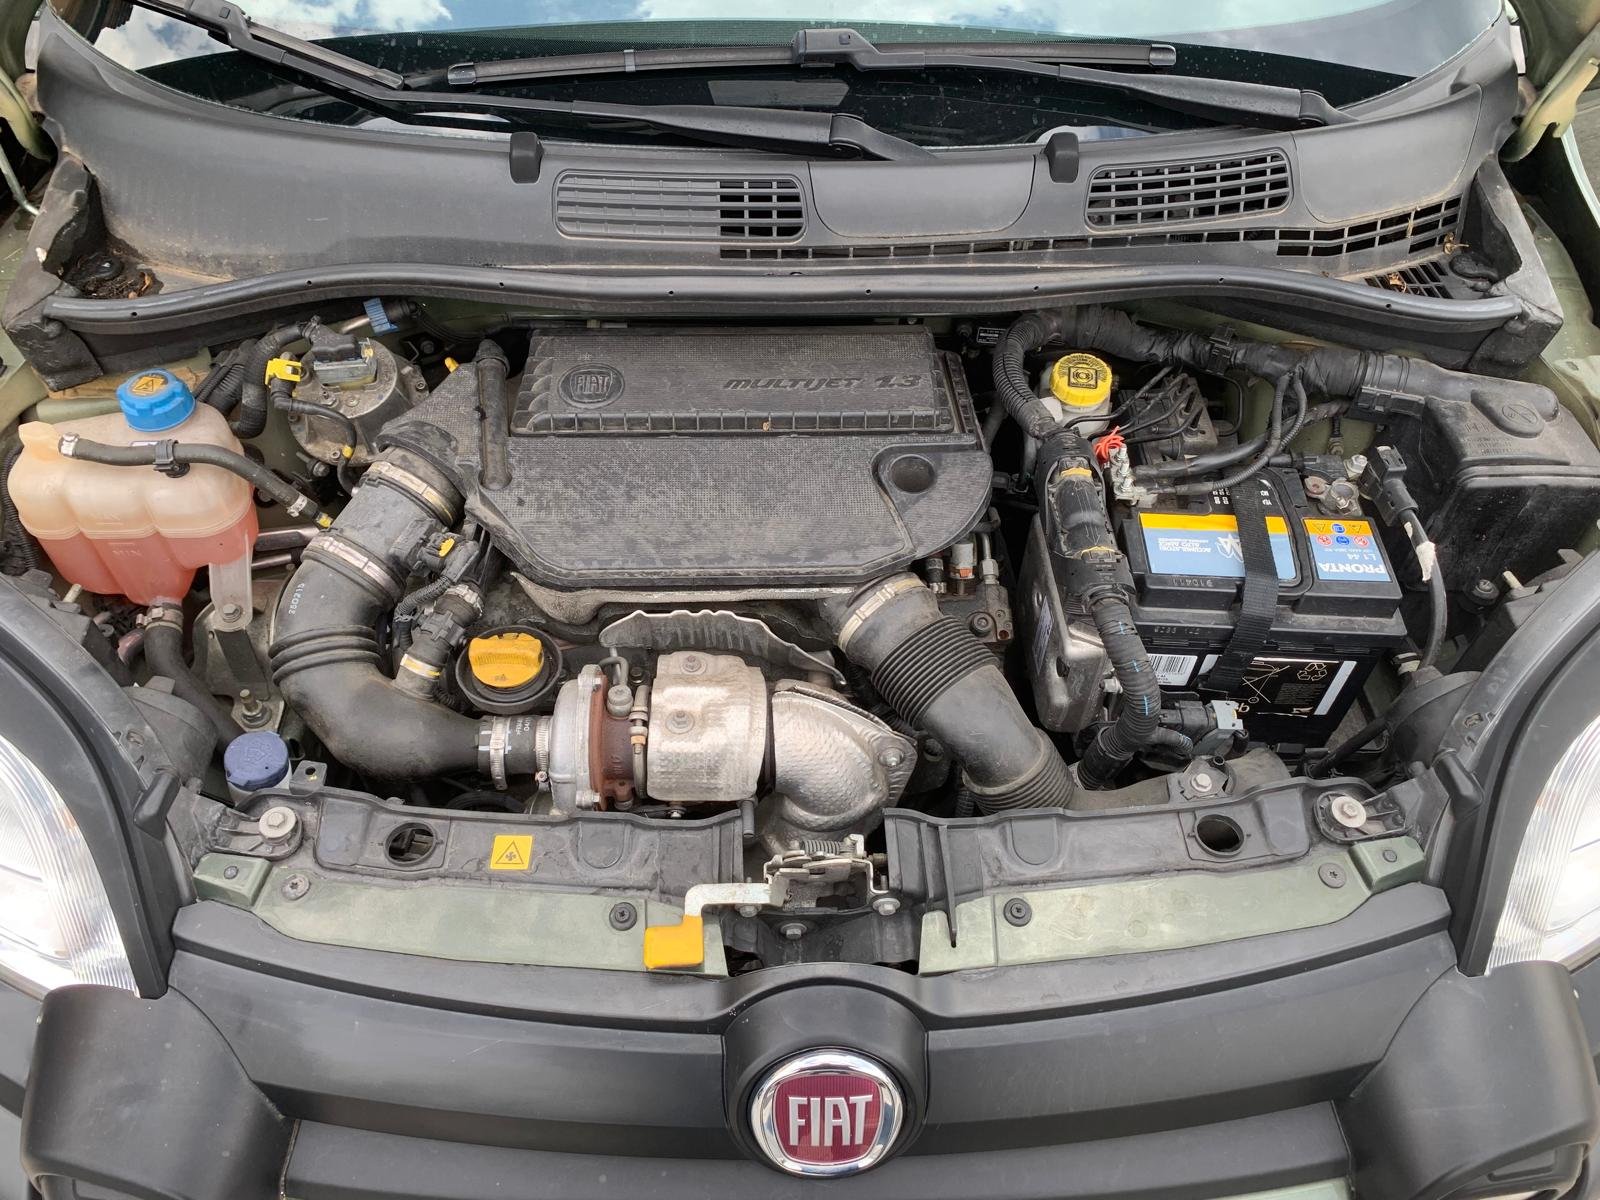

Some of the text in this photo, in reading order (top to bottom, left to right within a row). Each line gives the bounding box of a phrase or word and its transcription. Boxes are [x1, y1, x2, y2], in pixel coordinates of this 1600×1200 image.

[573, 374, 611, 394] FIAT
[722, 374, 922, 392] MULTIJET 1.3
[1318, 562, 1386, 574] PRONTA
[788, 1094, 873, 1147] FIAT
